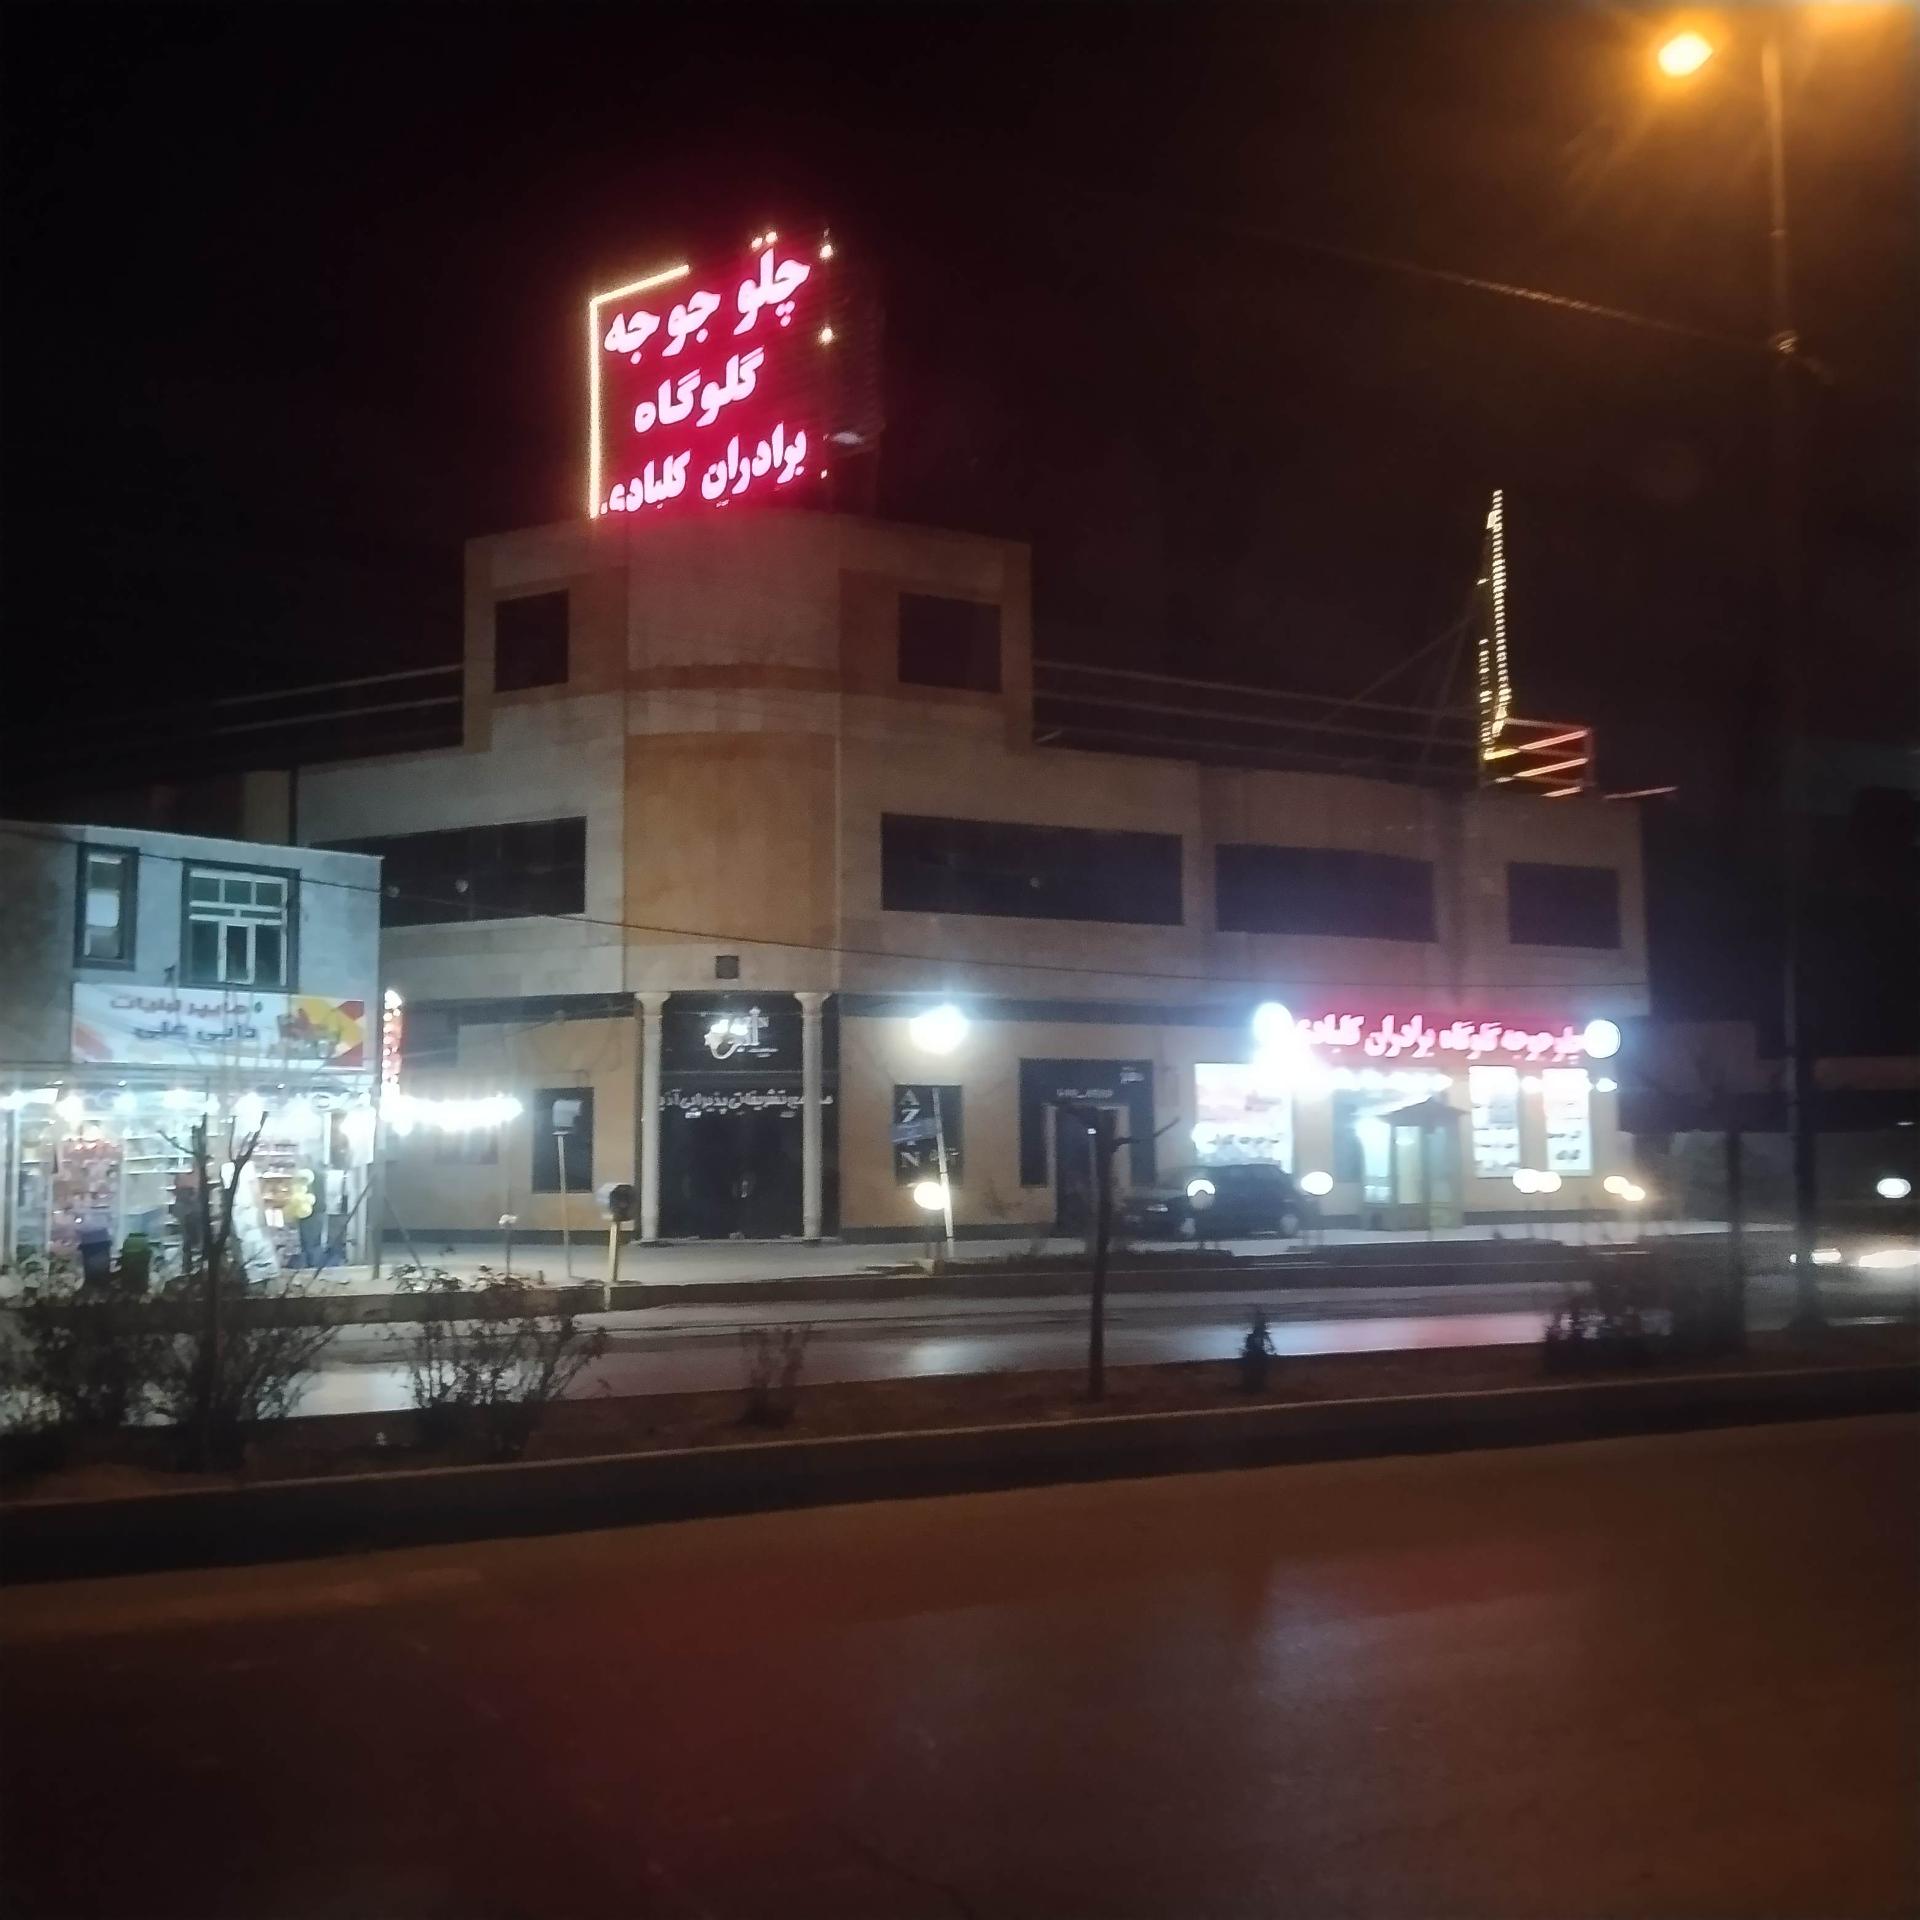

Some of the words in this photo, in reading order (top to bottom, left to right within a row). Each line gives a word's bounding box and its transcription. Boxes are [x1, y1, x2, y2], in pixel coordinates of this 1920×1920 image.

[734, 246, 812, 335] چلو
[633, 345, 765, 433] گلوگاه
[701, 421, 807, 507] برادران
